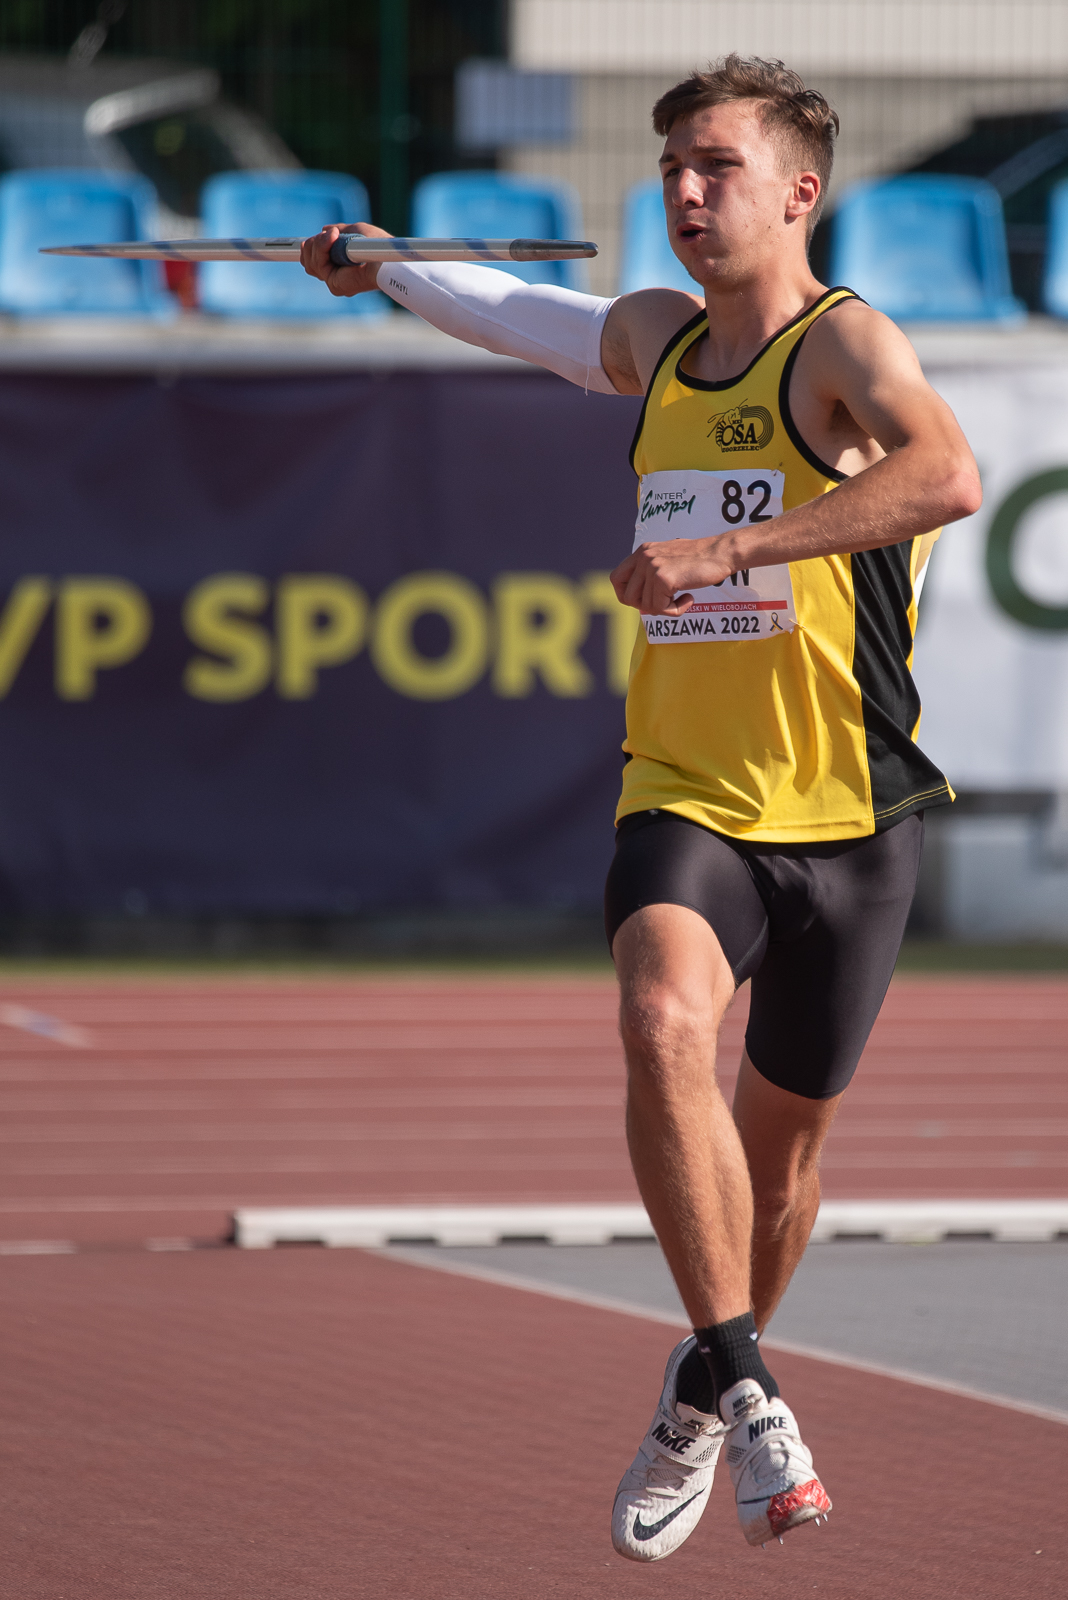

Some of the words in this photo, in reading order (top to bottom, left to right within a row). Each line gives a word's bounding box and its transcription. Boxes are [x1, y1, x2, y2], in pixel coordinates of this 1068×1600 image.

[721, 423, 758, 446] OSA
[641, 490, 696, 522] Europol
[721, 480, 773, 524] 82
[711, 603, 757, 611] WIELOBOJACH
[720, 616, 760, 634] 2022
[651, 1421, 697, 1456] NIKE
[748, 1416, 788, 1444] NIKE
